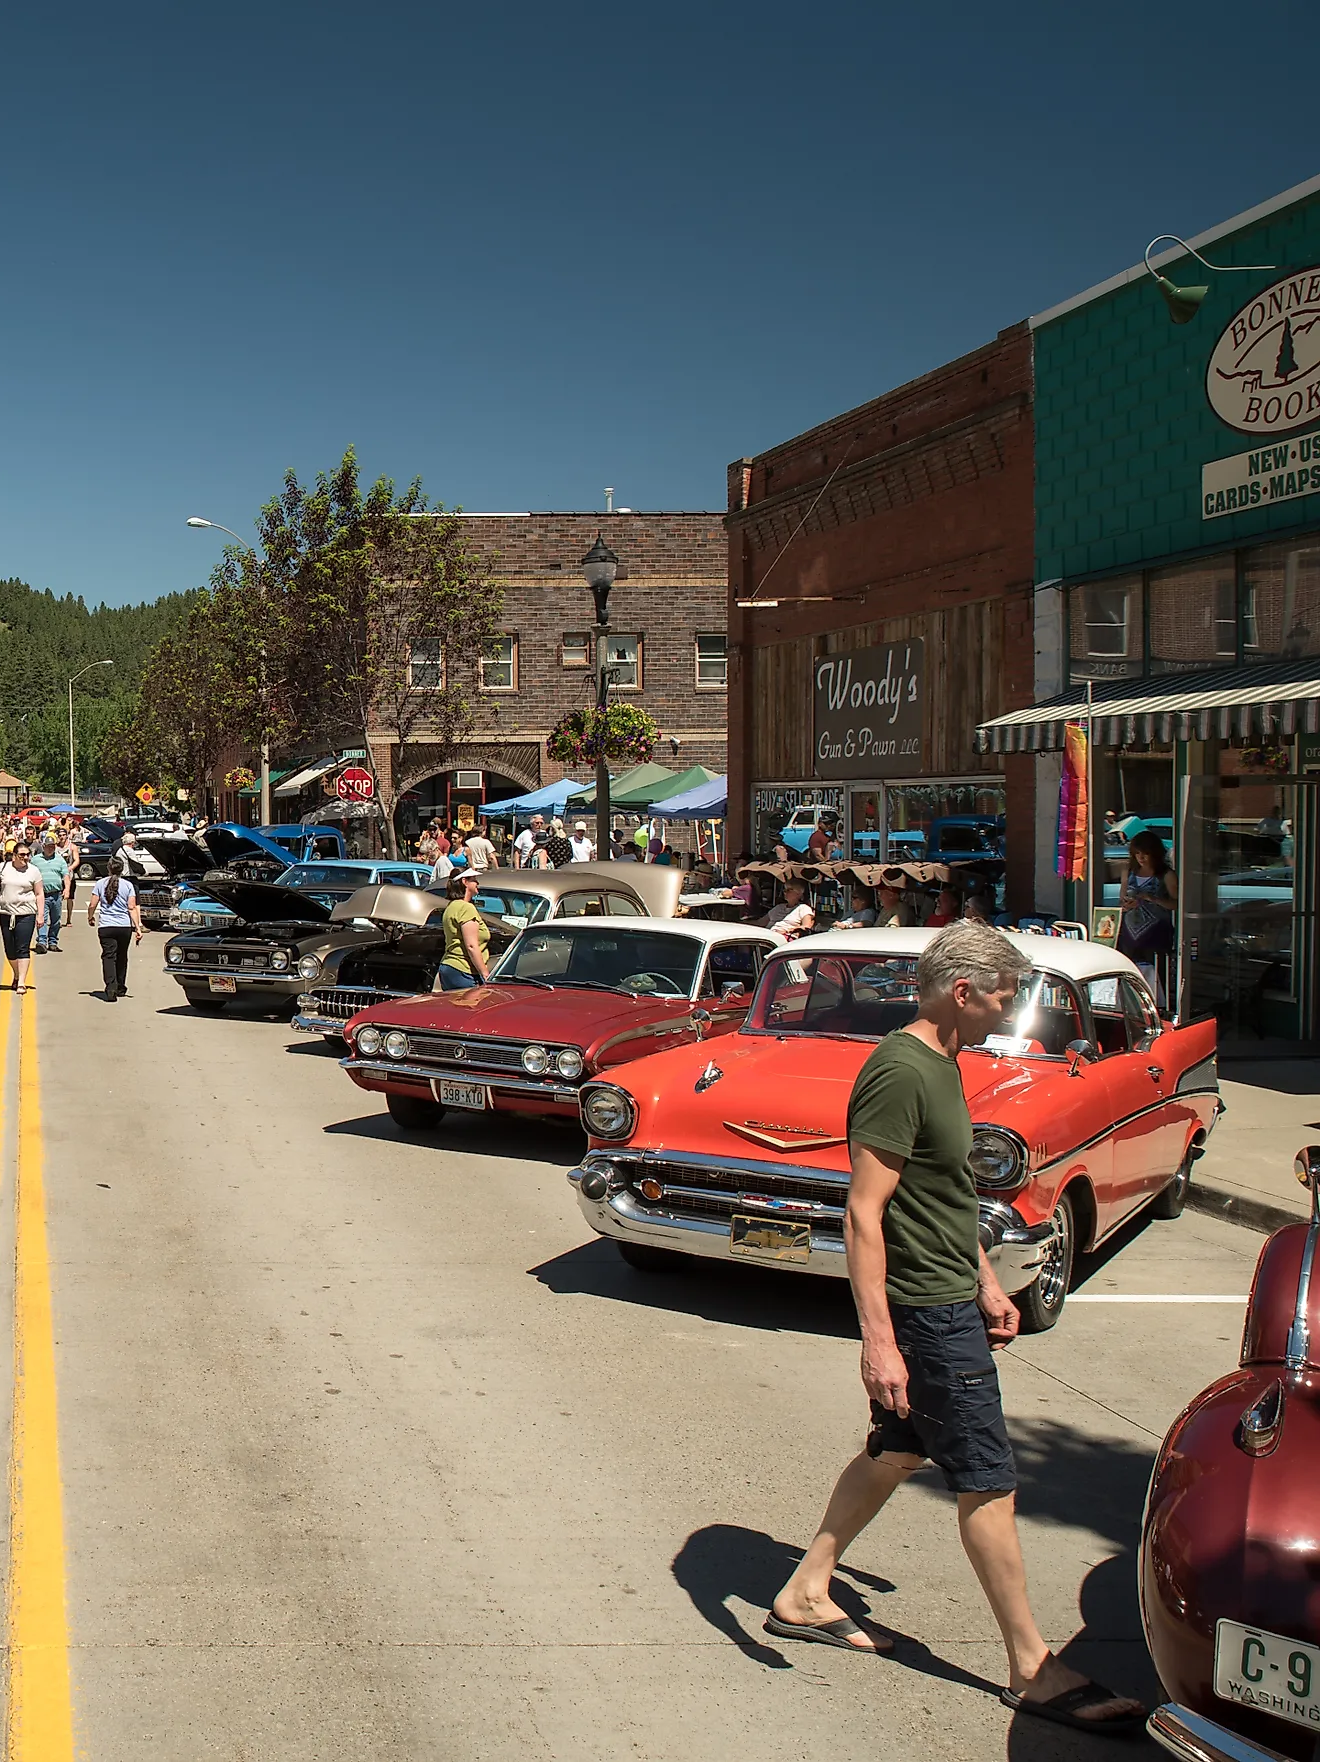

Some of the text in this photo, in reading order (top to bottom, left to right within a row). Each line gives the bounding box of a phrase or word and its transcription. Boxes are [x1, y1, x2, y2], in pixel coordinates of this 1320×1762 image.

[1248, 445, 1289, 477] NEW
[1204, 464, 1320, 516] CARDS MAPS
[817, 643, 917, 724] Woody's
[818, 731, 842, 759] Gun
[844, 728, 856, 757] &
[858, 727, 896, 757] Pawn
[340, 779, 371, 794] STOP
[761, 790, 777, 812] BUY
[811, 788, 839, 811] TRADE
